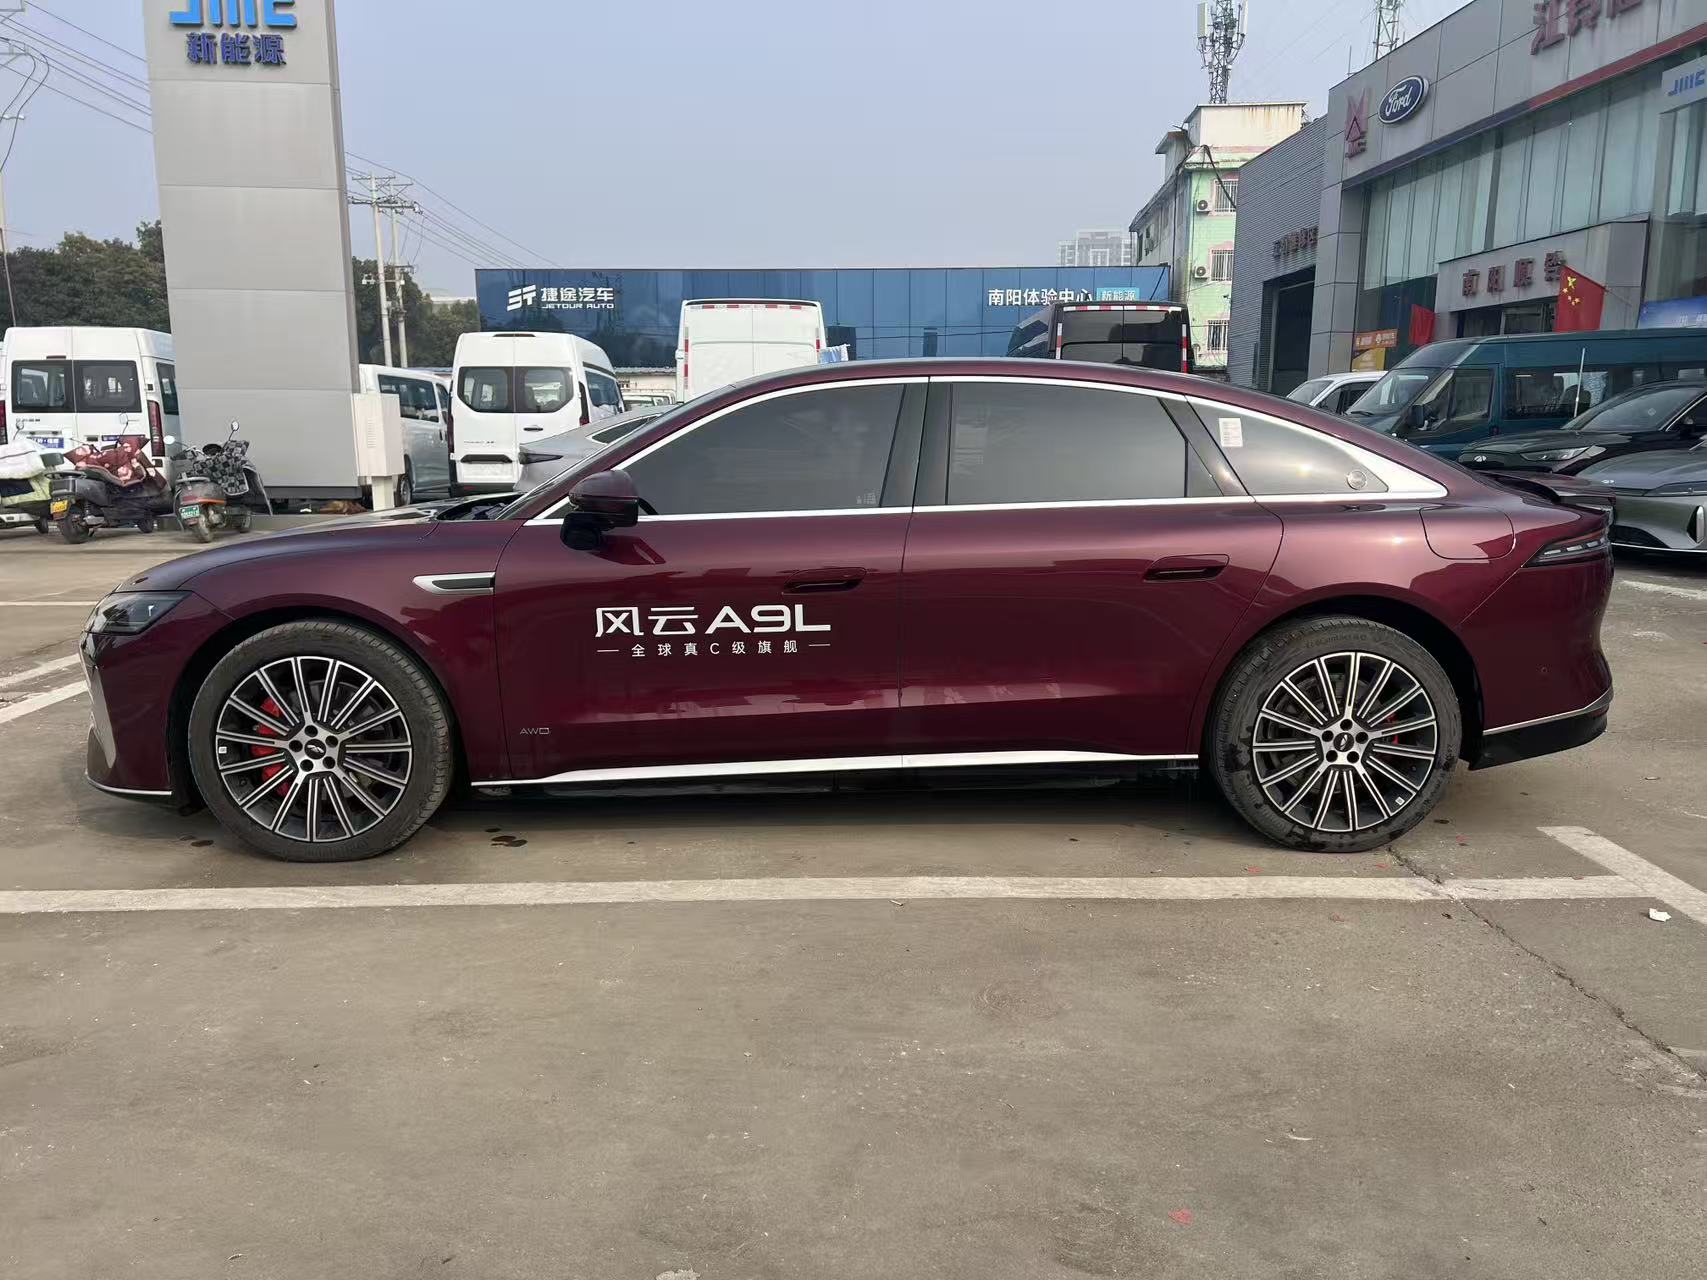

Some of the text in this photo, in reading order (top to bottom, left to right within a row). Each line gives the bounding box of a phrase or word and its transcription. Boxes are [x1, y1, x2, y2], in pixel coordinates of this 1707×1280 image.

[186, 32, 287, 65] 新能源
[1385, 84, 1414, 117] Ford
[540, 287, 614, 302] 捷途汽车
[988, 288, 1137, 306] 南阳体验中心 新能源
[631, 640, 798, 657] 全球真C级旗舰
